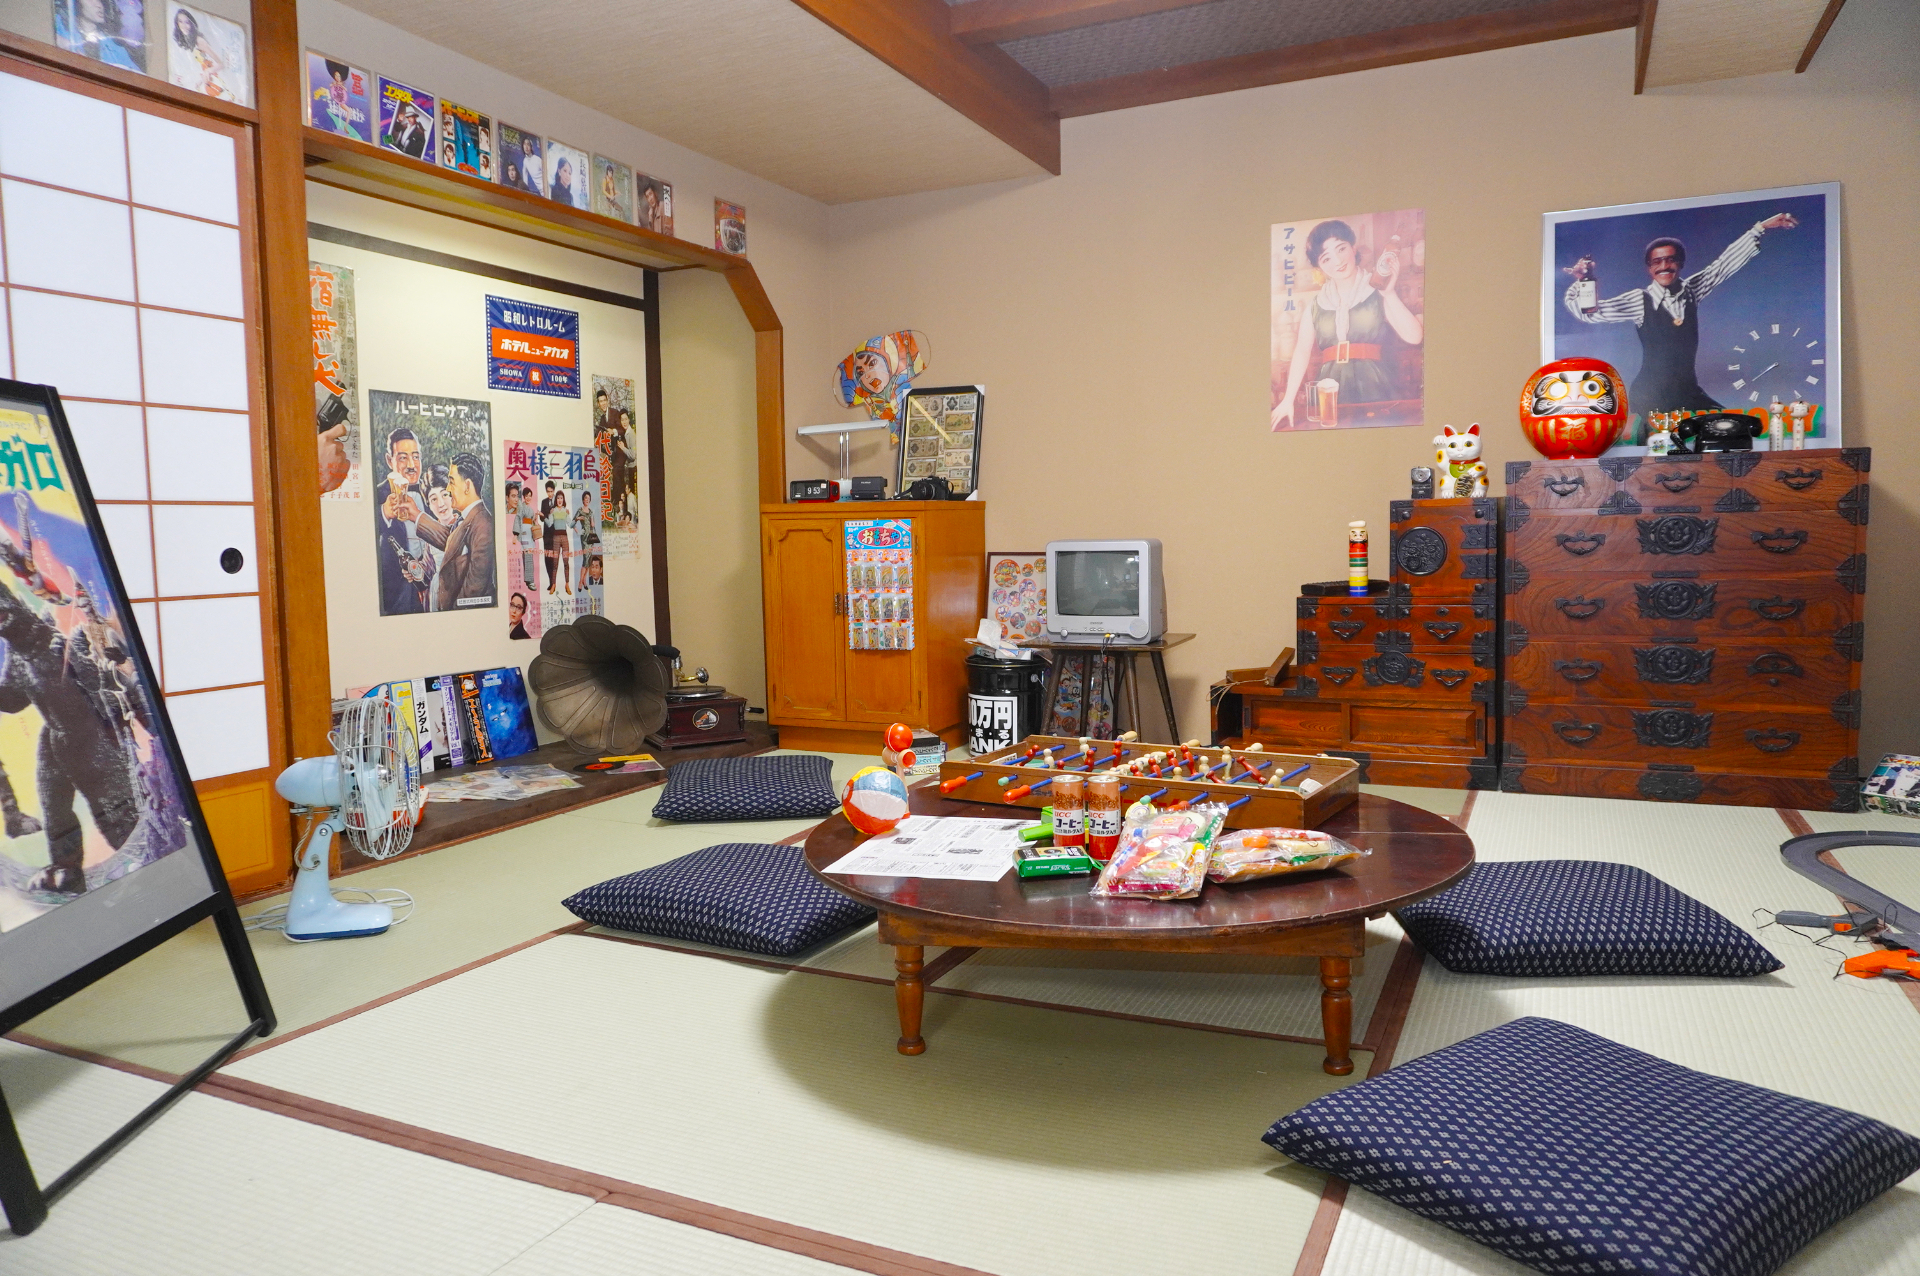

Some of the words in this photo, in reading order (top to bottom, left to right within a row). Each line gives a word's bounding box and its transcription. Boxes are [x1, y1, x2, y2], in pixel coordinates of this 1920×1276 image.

[1283, 227, 1296, 311] アサヒビール
[503, 310, 566, 333] 昭和レトロルーム
[500, 338, 570, 360] ホテルニューアカオ
[499, 368, 523, 378] SHOWA
[531, 371, 540, 382] 祝
[551, 375, 568, 384] 100年
[352, 463, 360, 499] 田宮二郎
[416, 700, 429, 734] ガンダム
[968, 698, 1013, 730] 0万円
[969, 736, 1011, 754] ANK
[1055, 818, 1081, 829] コーヒー
[1089, 818, 1115, 830] コーヒー
